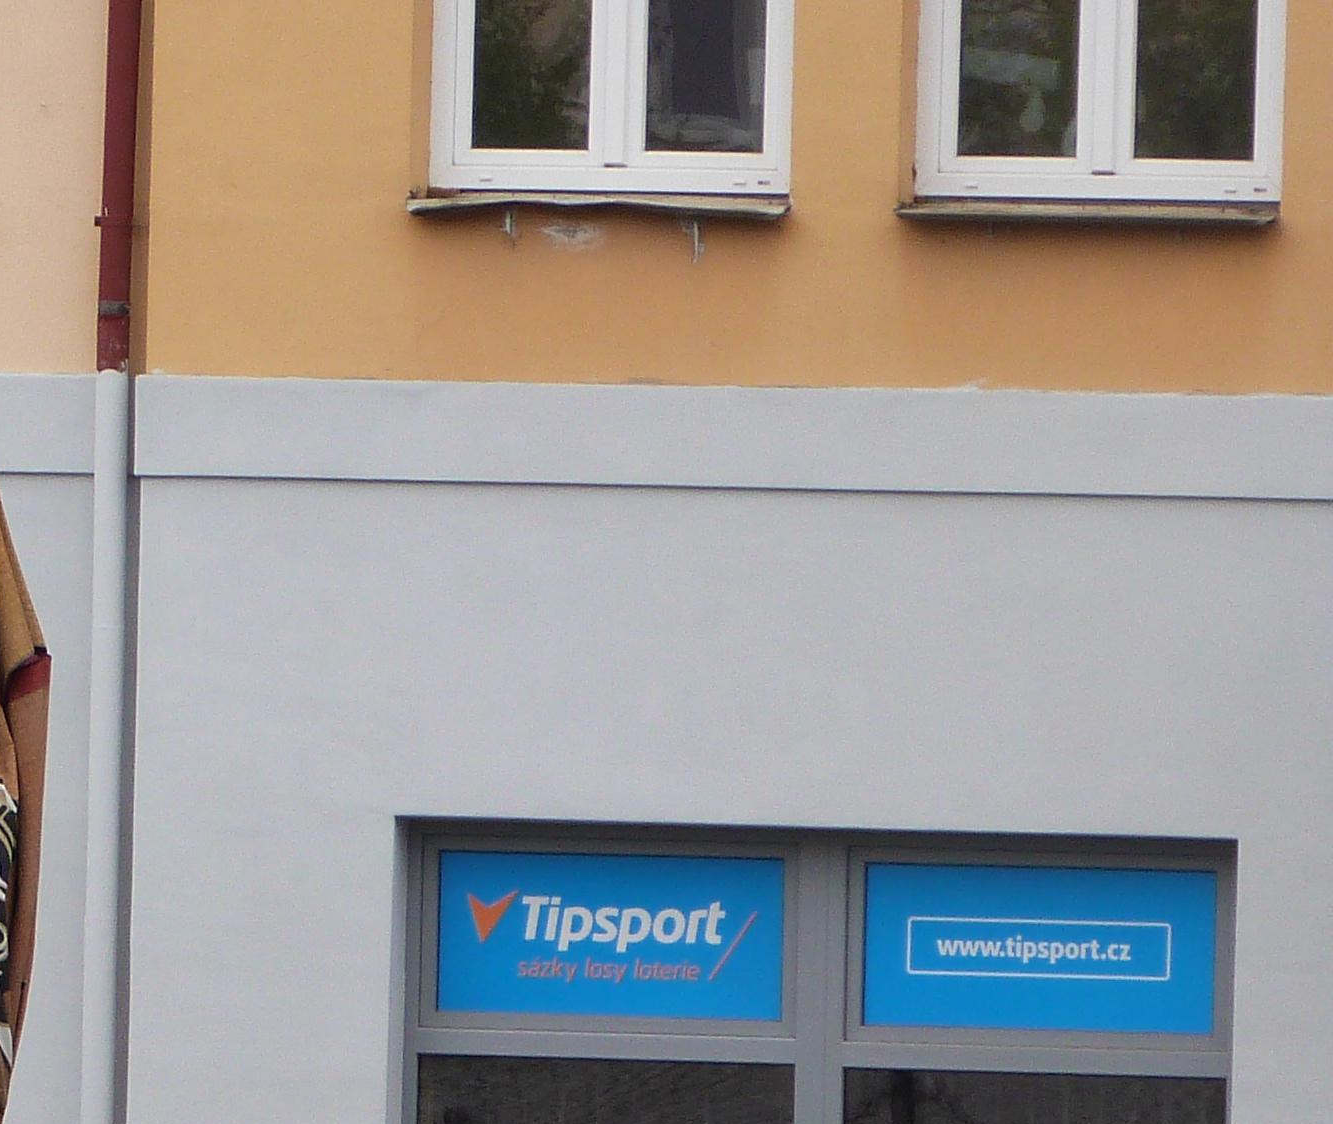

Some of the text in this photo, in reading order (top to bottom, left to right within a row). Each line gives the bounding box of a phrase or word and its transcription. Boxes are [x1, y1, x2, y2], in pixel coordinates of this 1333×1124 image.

[522, 895, 726, 953] Tipsport
[936, 935, 1131, 965] www.tipsport.cz
[517, 956, 700, 984] sázky losy loterie
